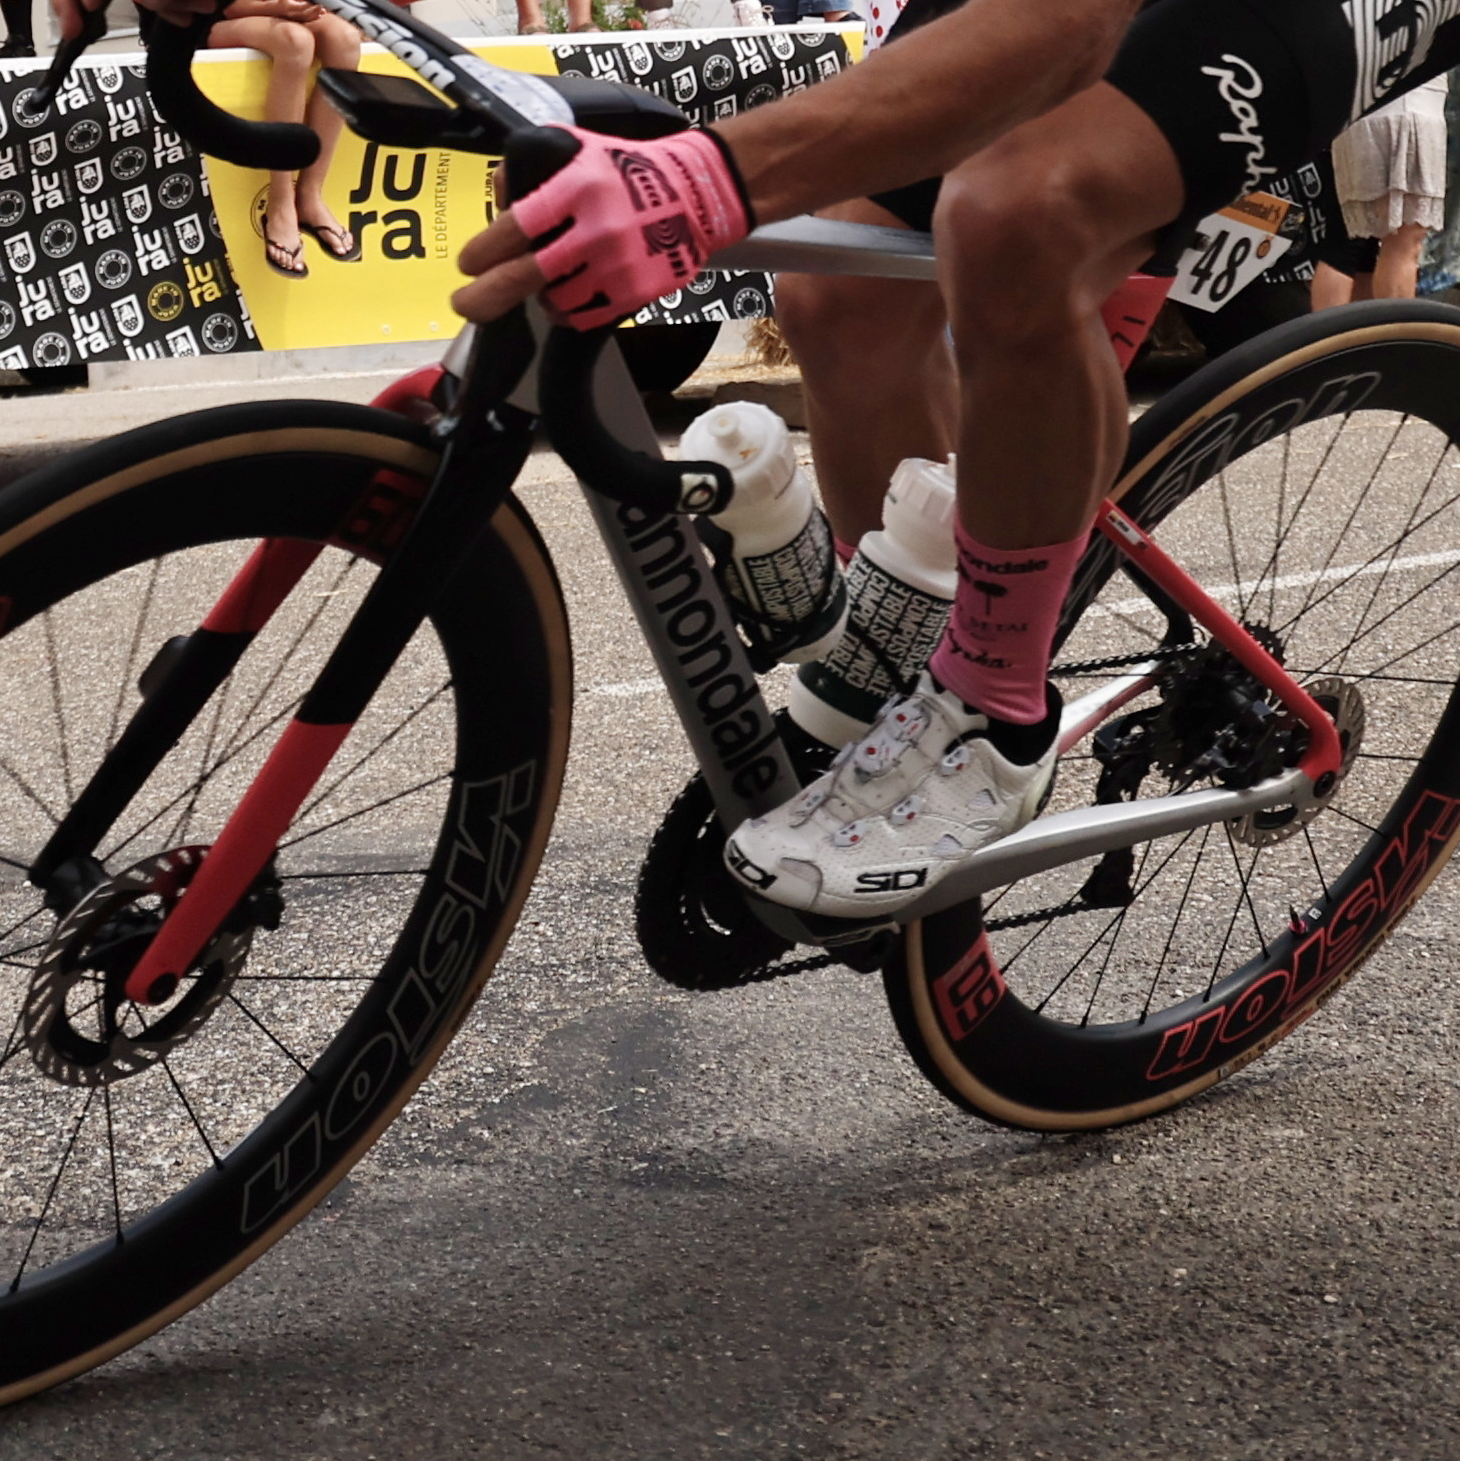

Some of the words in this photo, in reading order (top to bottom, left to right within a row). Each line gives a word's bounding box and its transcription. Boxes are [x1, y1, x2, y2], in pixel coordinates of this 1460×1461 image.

[731, 36, 758, 61] ju
[738, 55, 768, 80] ra
[1200, 53, 1280, 202] Raph
[30, 168, 61, 199] ju
[349, 143, 428, 205] ju
[33, 191, 66, 215] ra
[435, 151, 453, 236] DÉPARTEMENT
[78, 195, 109, 228] ju
[82, 220, 116, 245] ra
[132, 225, 163, 259] ju
[350, 207, 427, 261] ra
[138, 249, 171, 277] ra
[435, 240, 450, 260] LE
[183, 257, 215, 290] ju
[1191, 230, 1252, 305] 48
[189, 280, 222, 309] ra
[617, 497, 781, 802] annondale
[853, 866, 928, 894] SIDI
